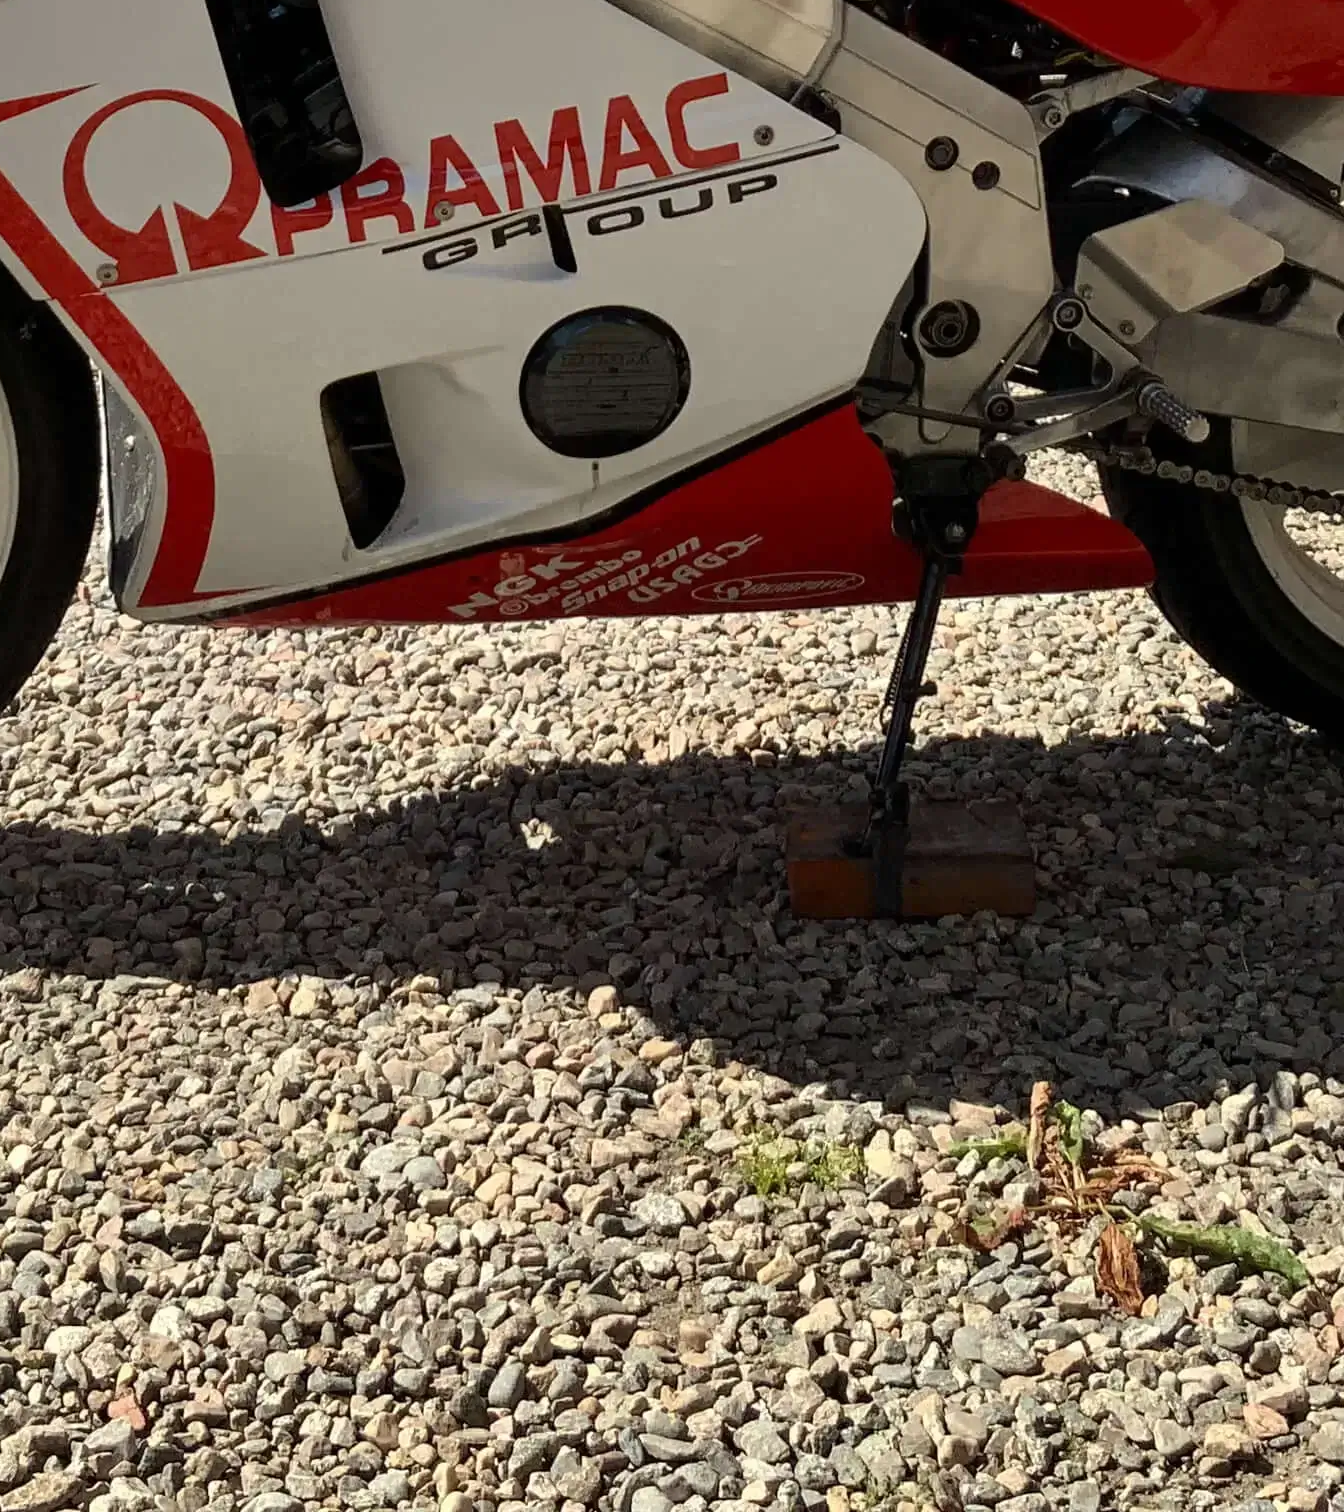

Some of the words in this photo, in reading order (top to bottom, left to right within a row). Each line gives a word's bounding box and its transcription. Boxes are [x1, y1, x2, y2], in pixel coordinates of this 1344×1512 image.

[271, 72, 741, 256] PRAMAC
[422, 173, 779, 271] GROUP
[448, 554, 585, 618] NGK
[522, 550, 643, 605] brembo
[562, 535, 702, 615] Snap-on
[628, 551, 729, 604] USAG
